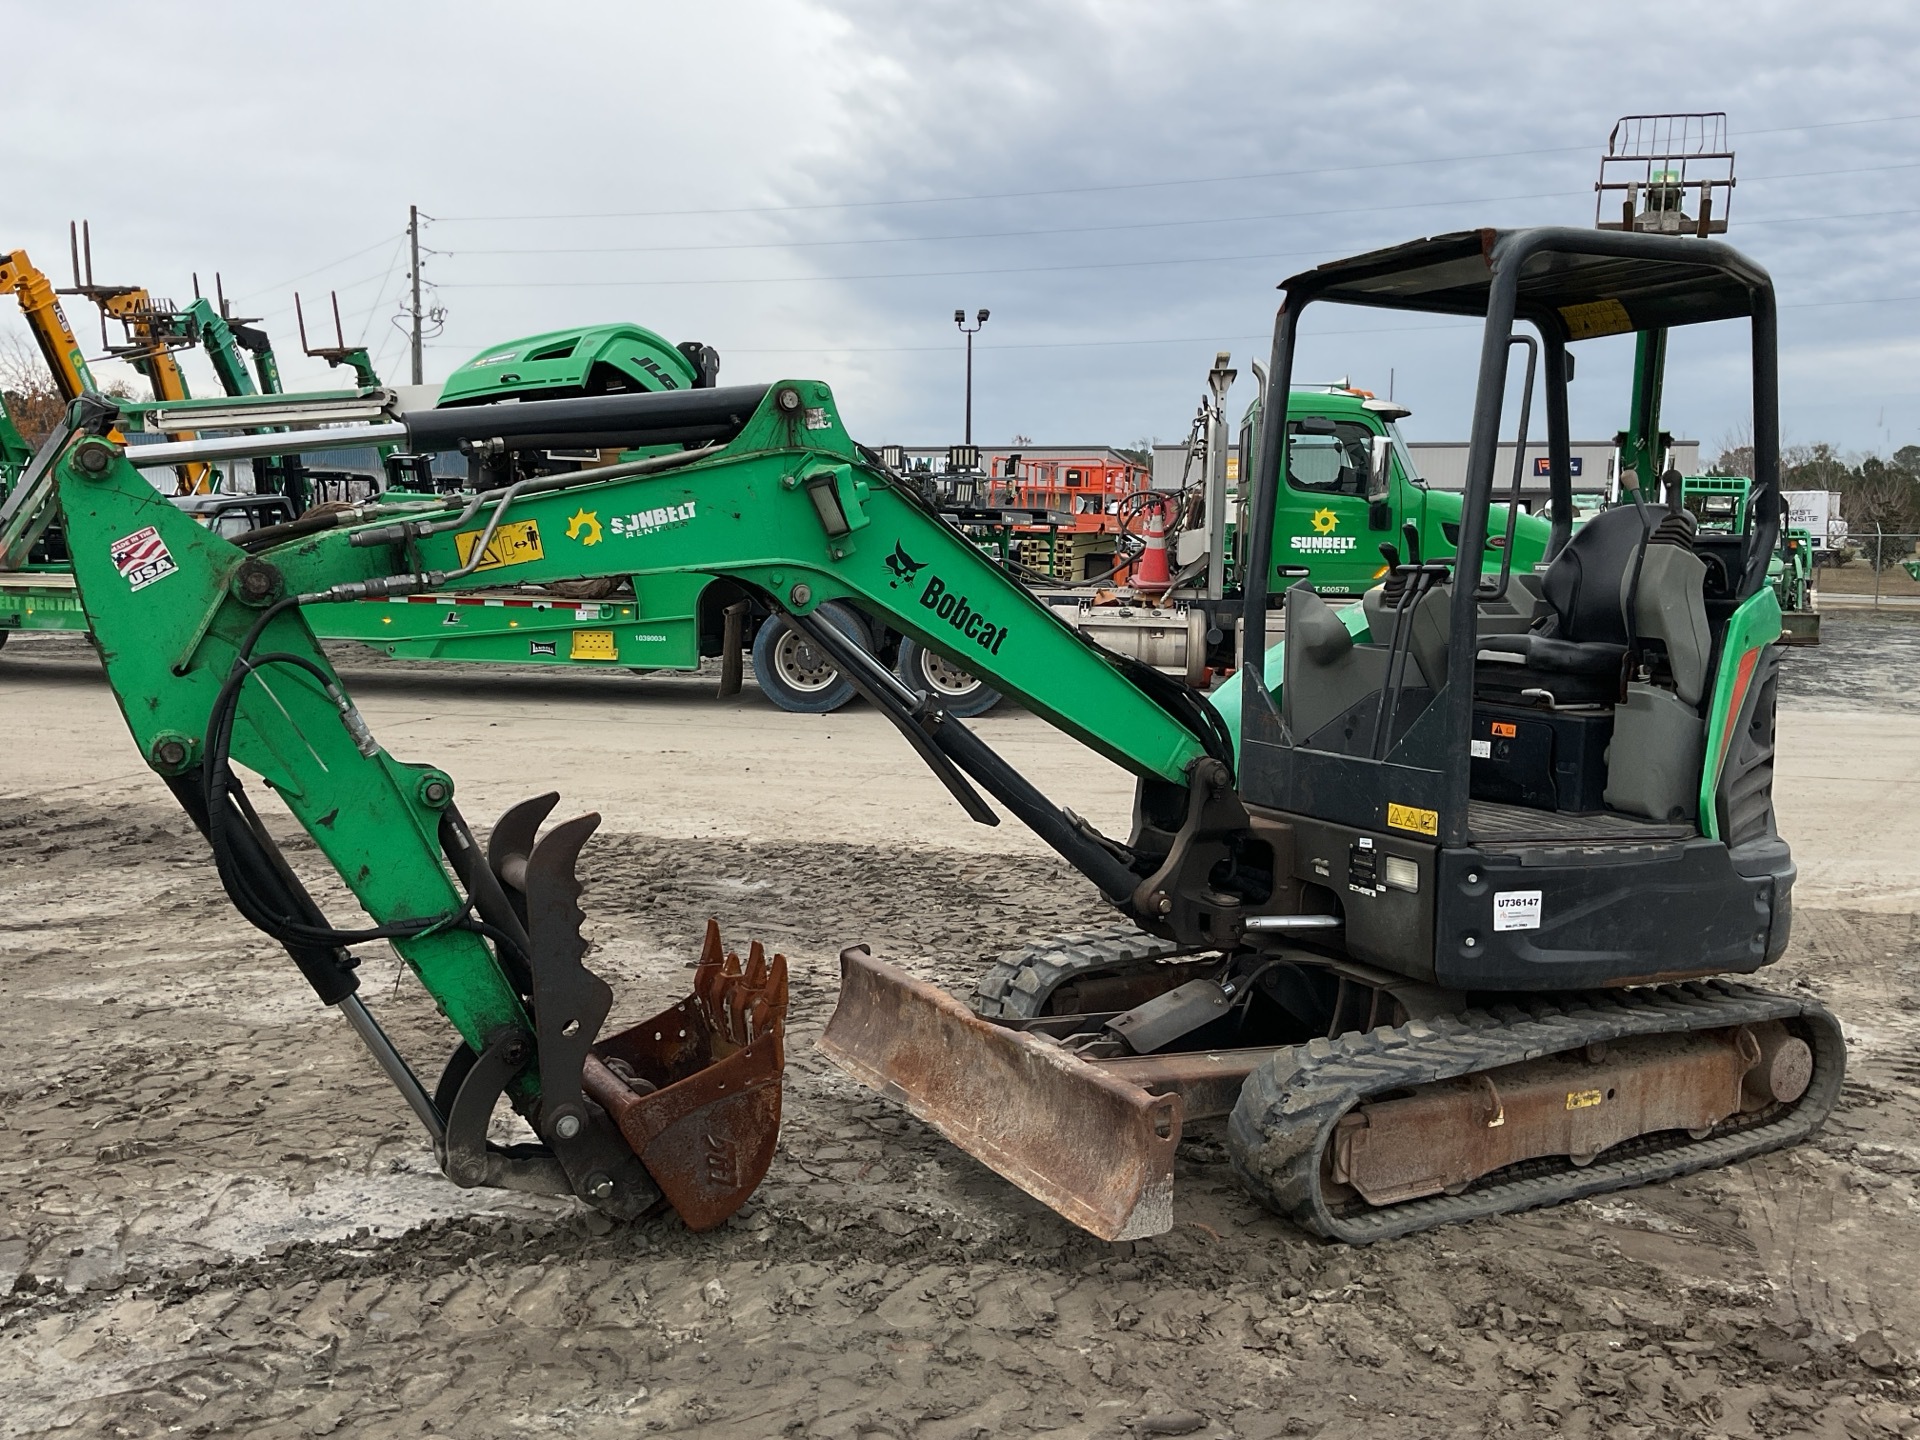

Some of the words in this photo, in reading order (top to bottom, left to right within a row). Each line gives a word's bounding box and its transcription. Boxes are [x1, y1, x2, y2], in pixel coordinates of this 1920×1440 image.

[52, 303, 71, 333] JCB
[630, 356, 679, 391] JLG
[1290, 536, 1356, 549] SUNBELT
[129, 558, 173, 585] USA
[919, 574, 1008, 656] Bobcat
[1498, 898, 1540, 908] U736147
